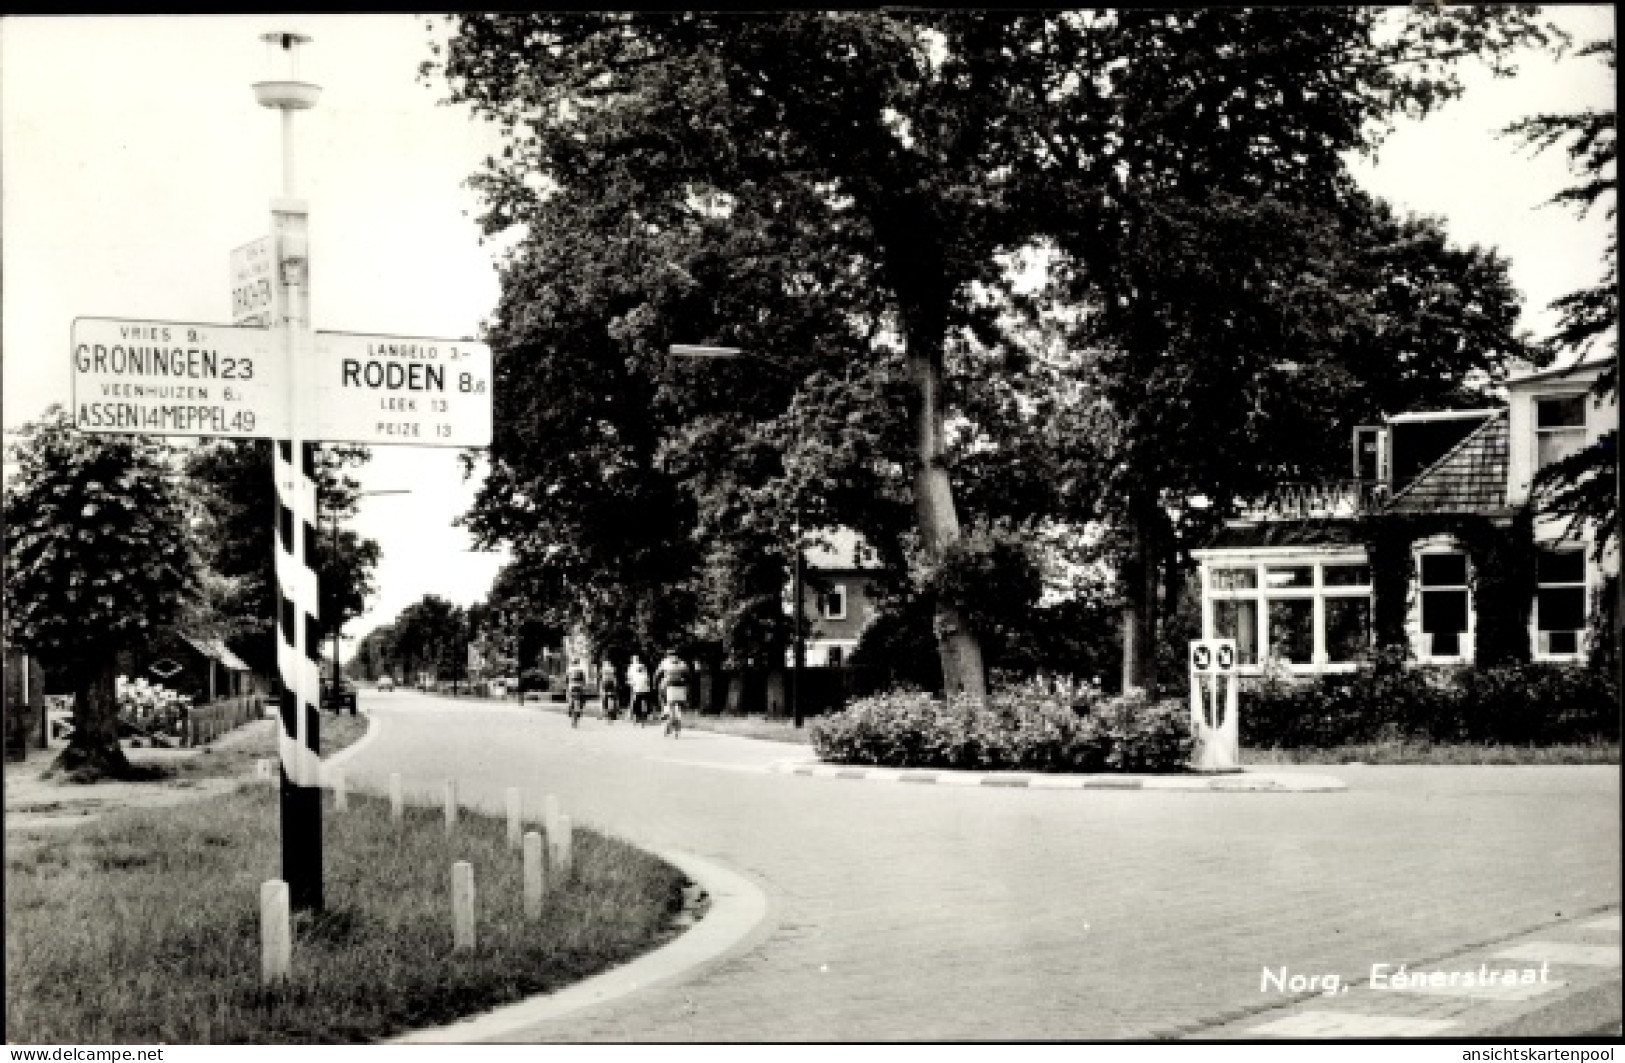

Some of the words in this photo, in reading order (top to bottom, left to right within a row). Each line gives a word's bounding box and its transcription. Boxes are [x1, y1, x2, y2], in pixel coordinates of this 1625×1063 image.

[120, 327, 172, 342] VRIES
[74, 344, 218, 379] GRONINGEN
[220, 357, 255, 380] 23
[342, 358, 446, 393] RODEN
[101, 383, 208, 400] VEENHUIZEN
[380, 397, 417, 412] LEEK
[430, 399, 449, 413] 13
[375, 421, 420, 437] PEIZE
[435, 422, 452, 438] 13
